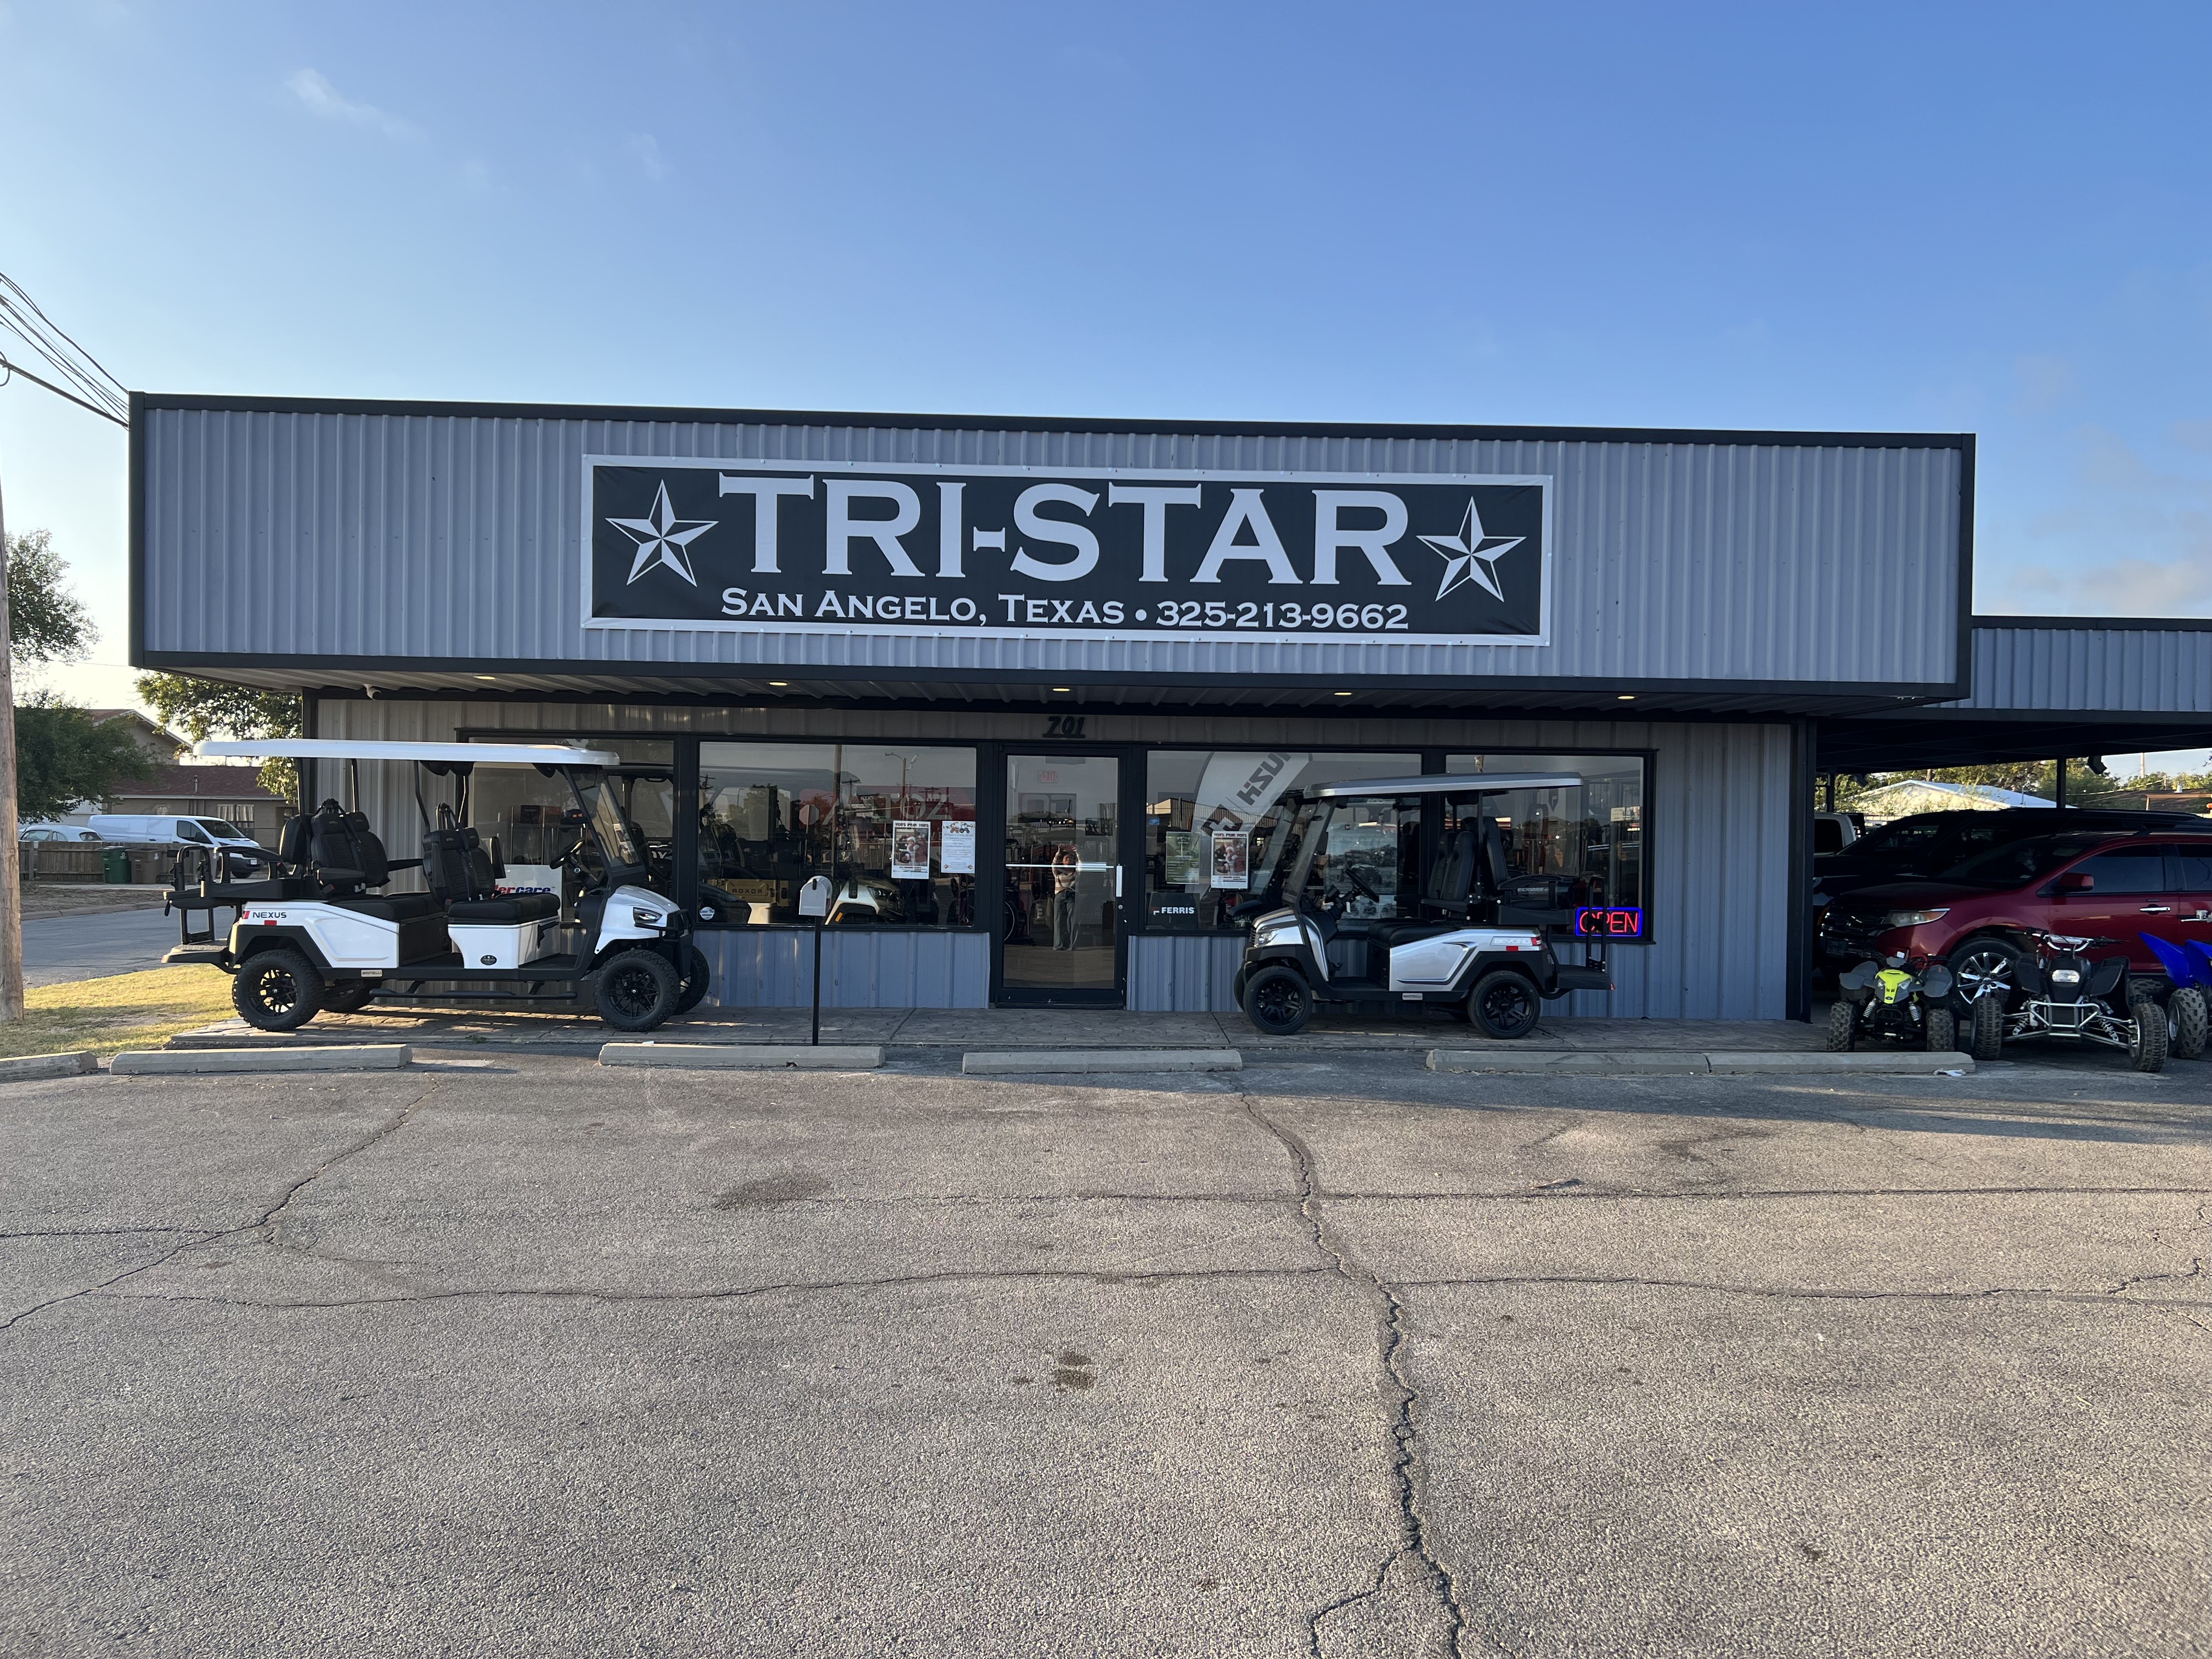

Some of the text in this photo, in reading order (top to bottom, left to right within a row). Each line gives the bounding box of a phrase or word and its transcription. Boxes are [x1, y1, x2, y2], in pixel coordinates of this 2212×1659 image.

[719, 472, 1412, 585] TRI-STAR
[721, 587, 1409, 630] SAN ANGELO, TEXAS 325-213-9662
[1043, 715, 1085, 738] 701
[1042, 770, 1056, 782] EXIT
[1161, 906, 1195, 915] FERRIS
